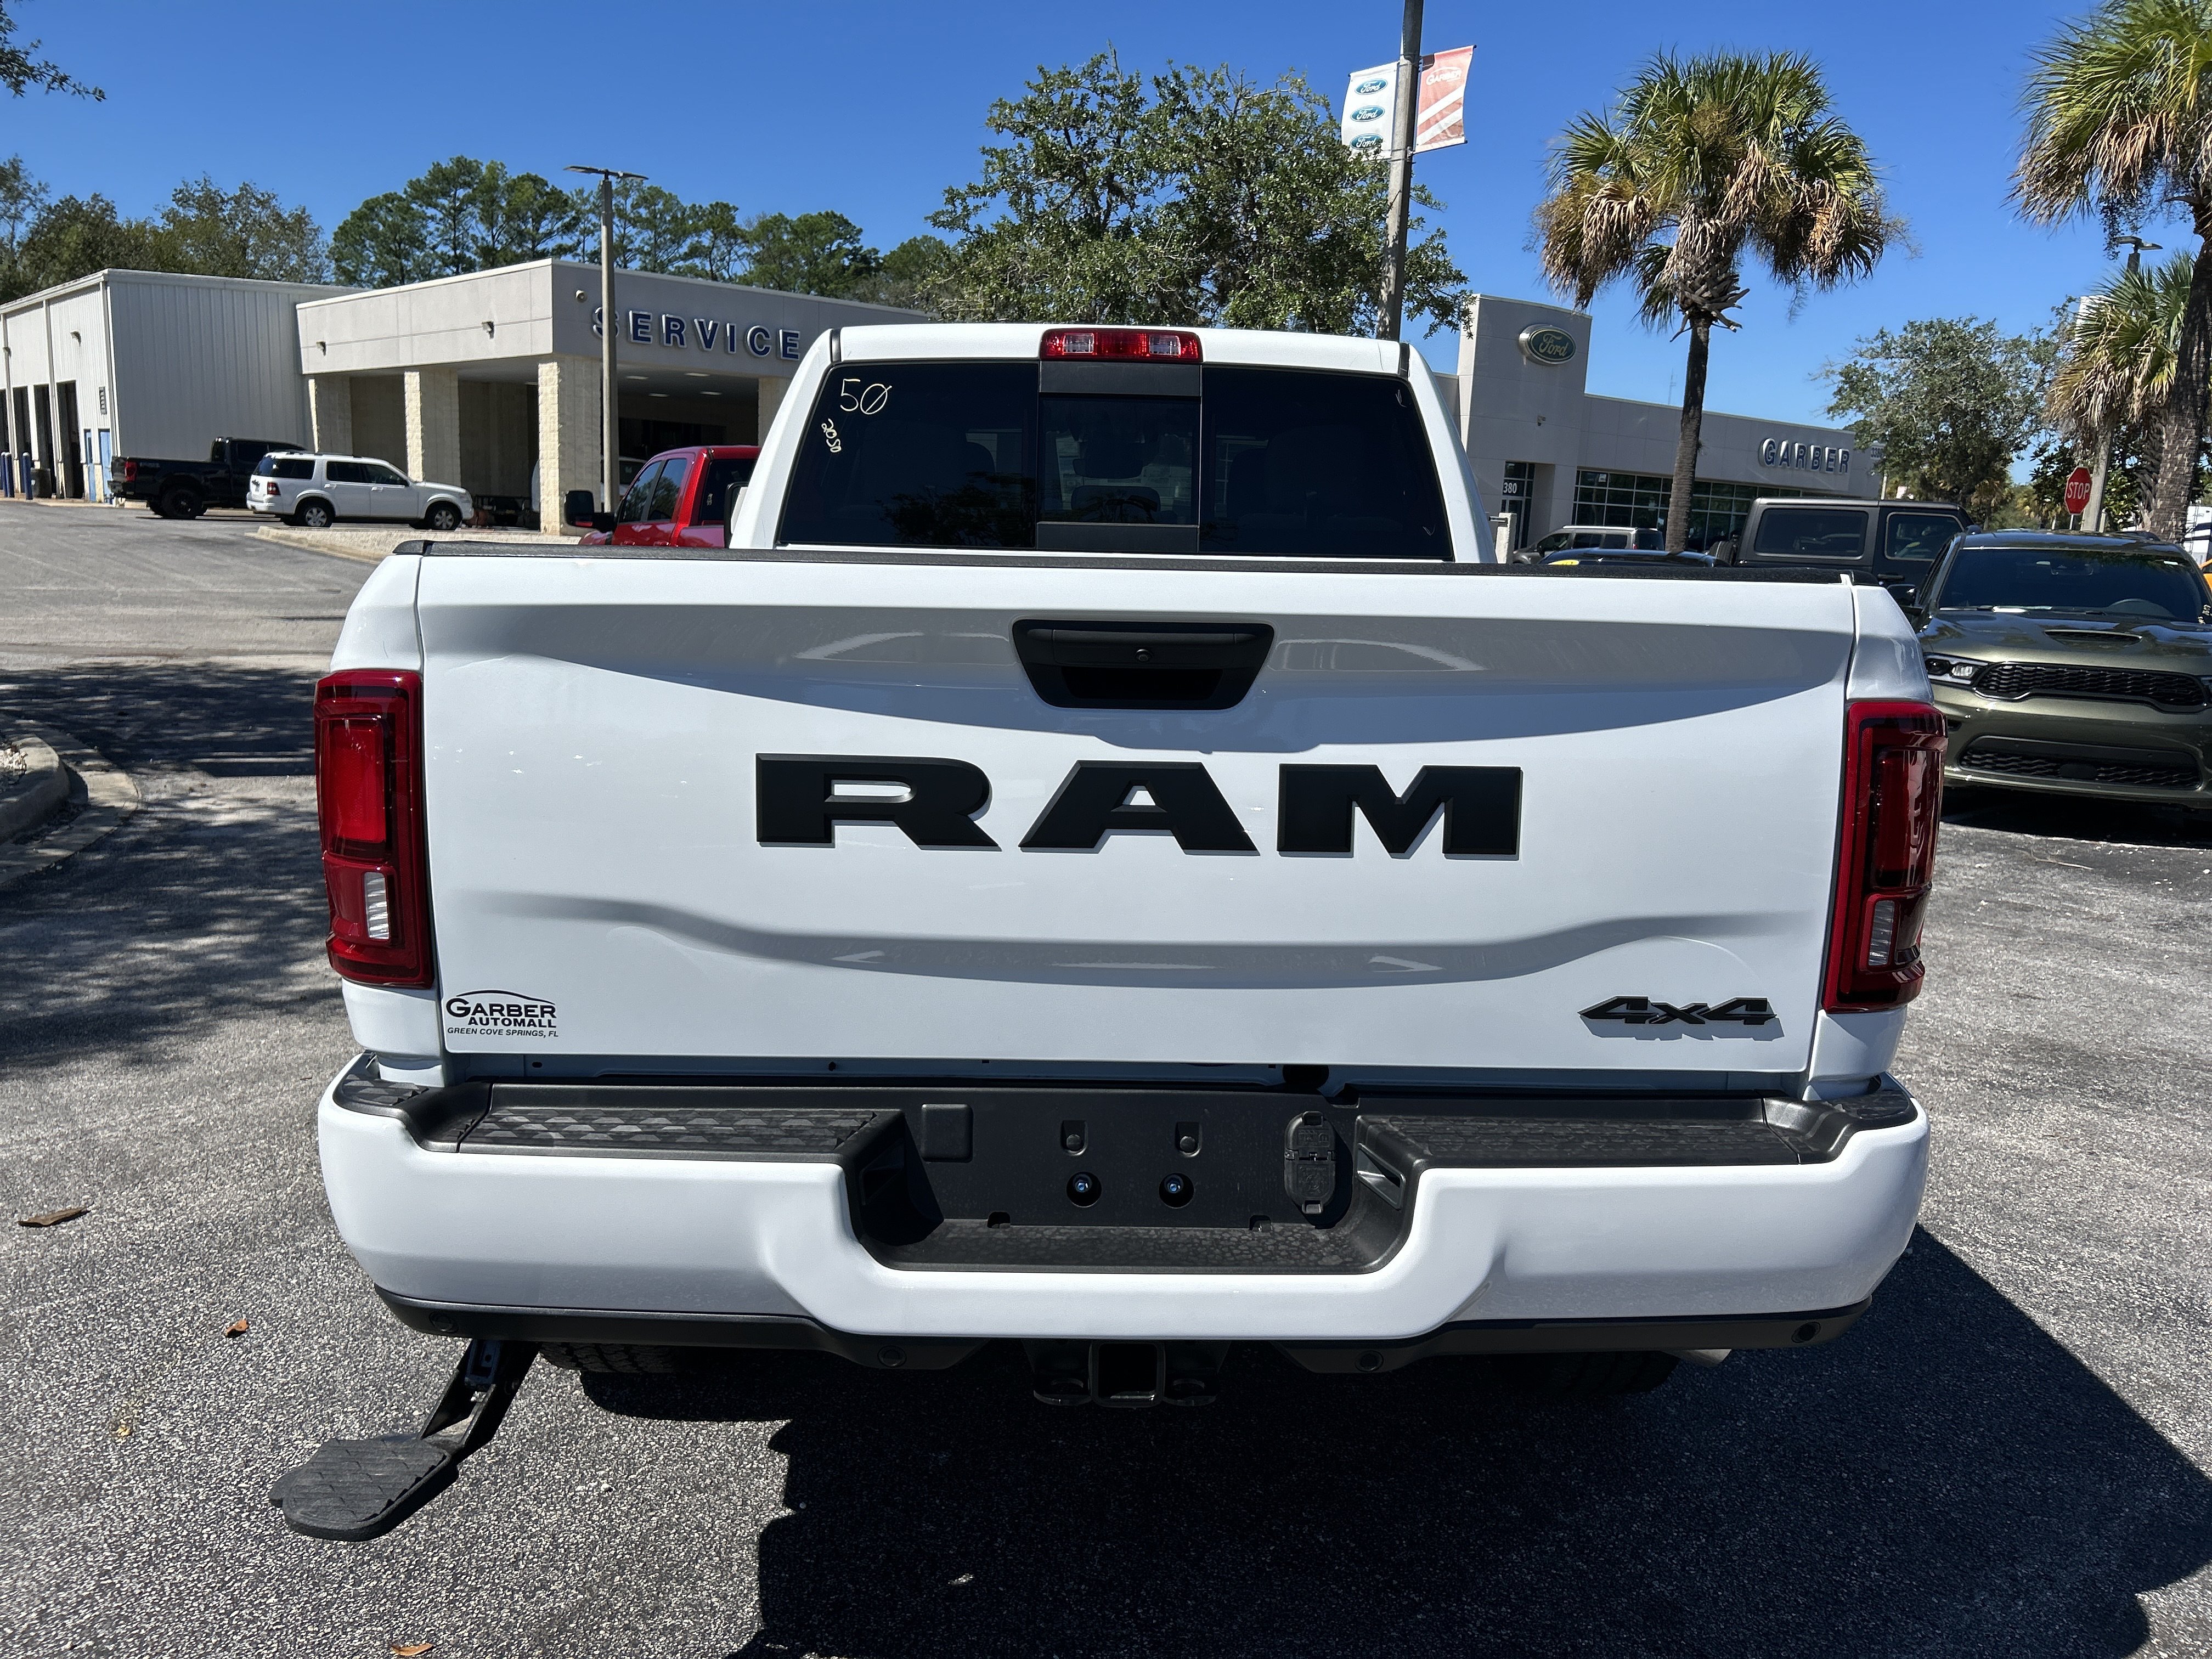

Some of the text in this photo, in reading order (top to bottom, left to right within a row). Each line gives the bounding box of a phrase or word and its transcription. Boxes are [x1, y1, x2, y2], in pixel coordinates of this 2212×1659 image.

[1360, 81, 1382, 93] Ford
[1356, 108, 1378, 120] Ford
[1539, 333, 1569, 357] Ford
[1759, 438, 1850, 475] GARBER
[2067, 482, 2090, 499] STOP
[756, 753, 1522, 856] RAM
[446, 997, 557, 1018] GARBER
[468, 1017, 557, 1028] AUTOMALL
[506, 1029, 546, 1038] SPRINGS,
